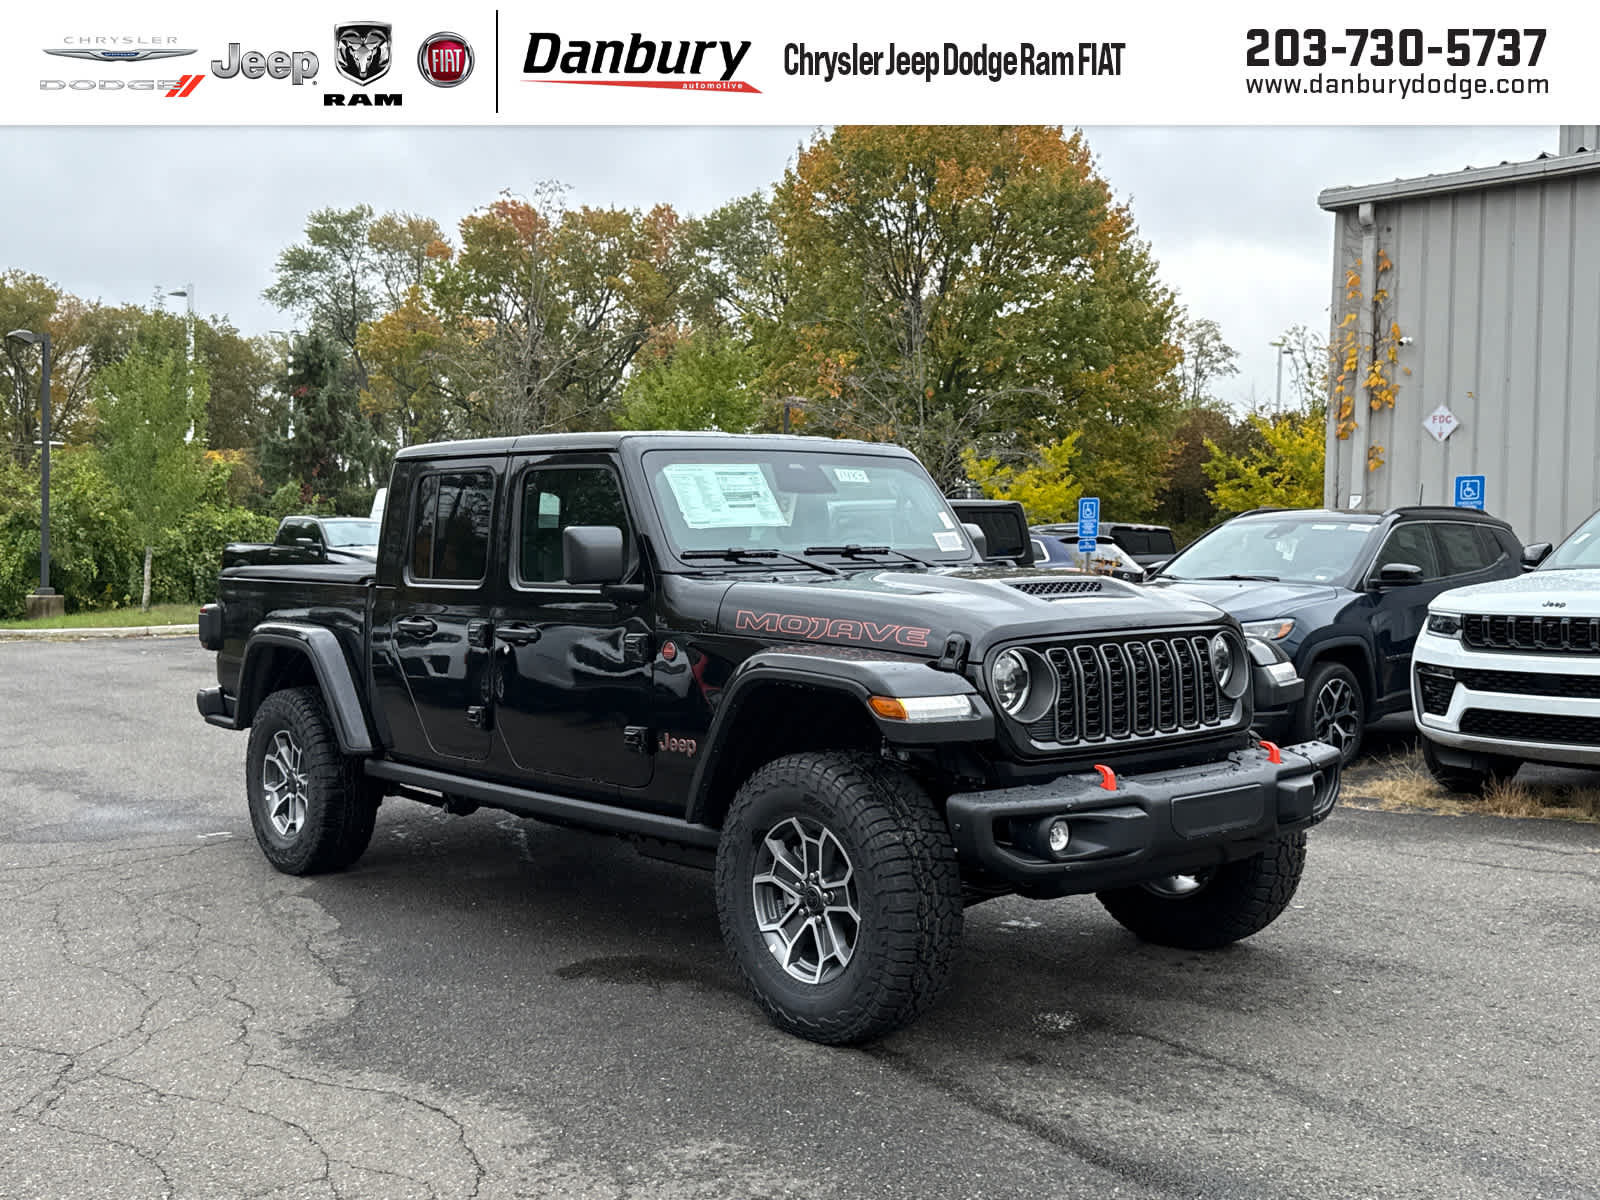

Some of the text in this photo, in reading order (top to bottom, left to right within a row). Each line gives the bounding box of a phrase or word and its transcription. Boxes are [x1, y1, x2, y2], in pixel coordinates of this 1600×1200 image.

[1432, 415, 1453, 424] FDC
[1541, 599, 1567, 609] Jeep
[735, 609, 931, 648] MOJAVE
[658, 732, 697, 758] Jeep
